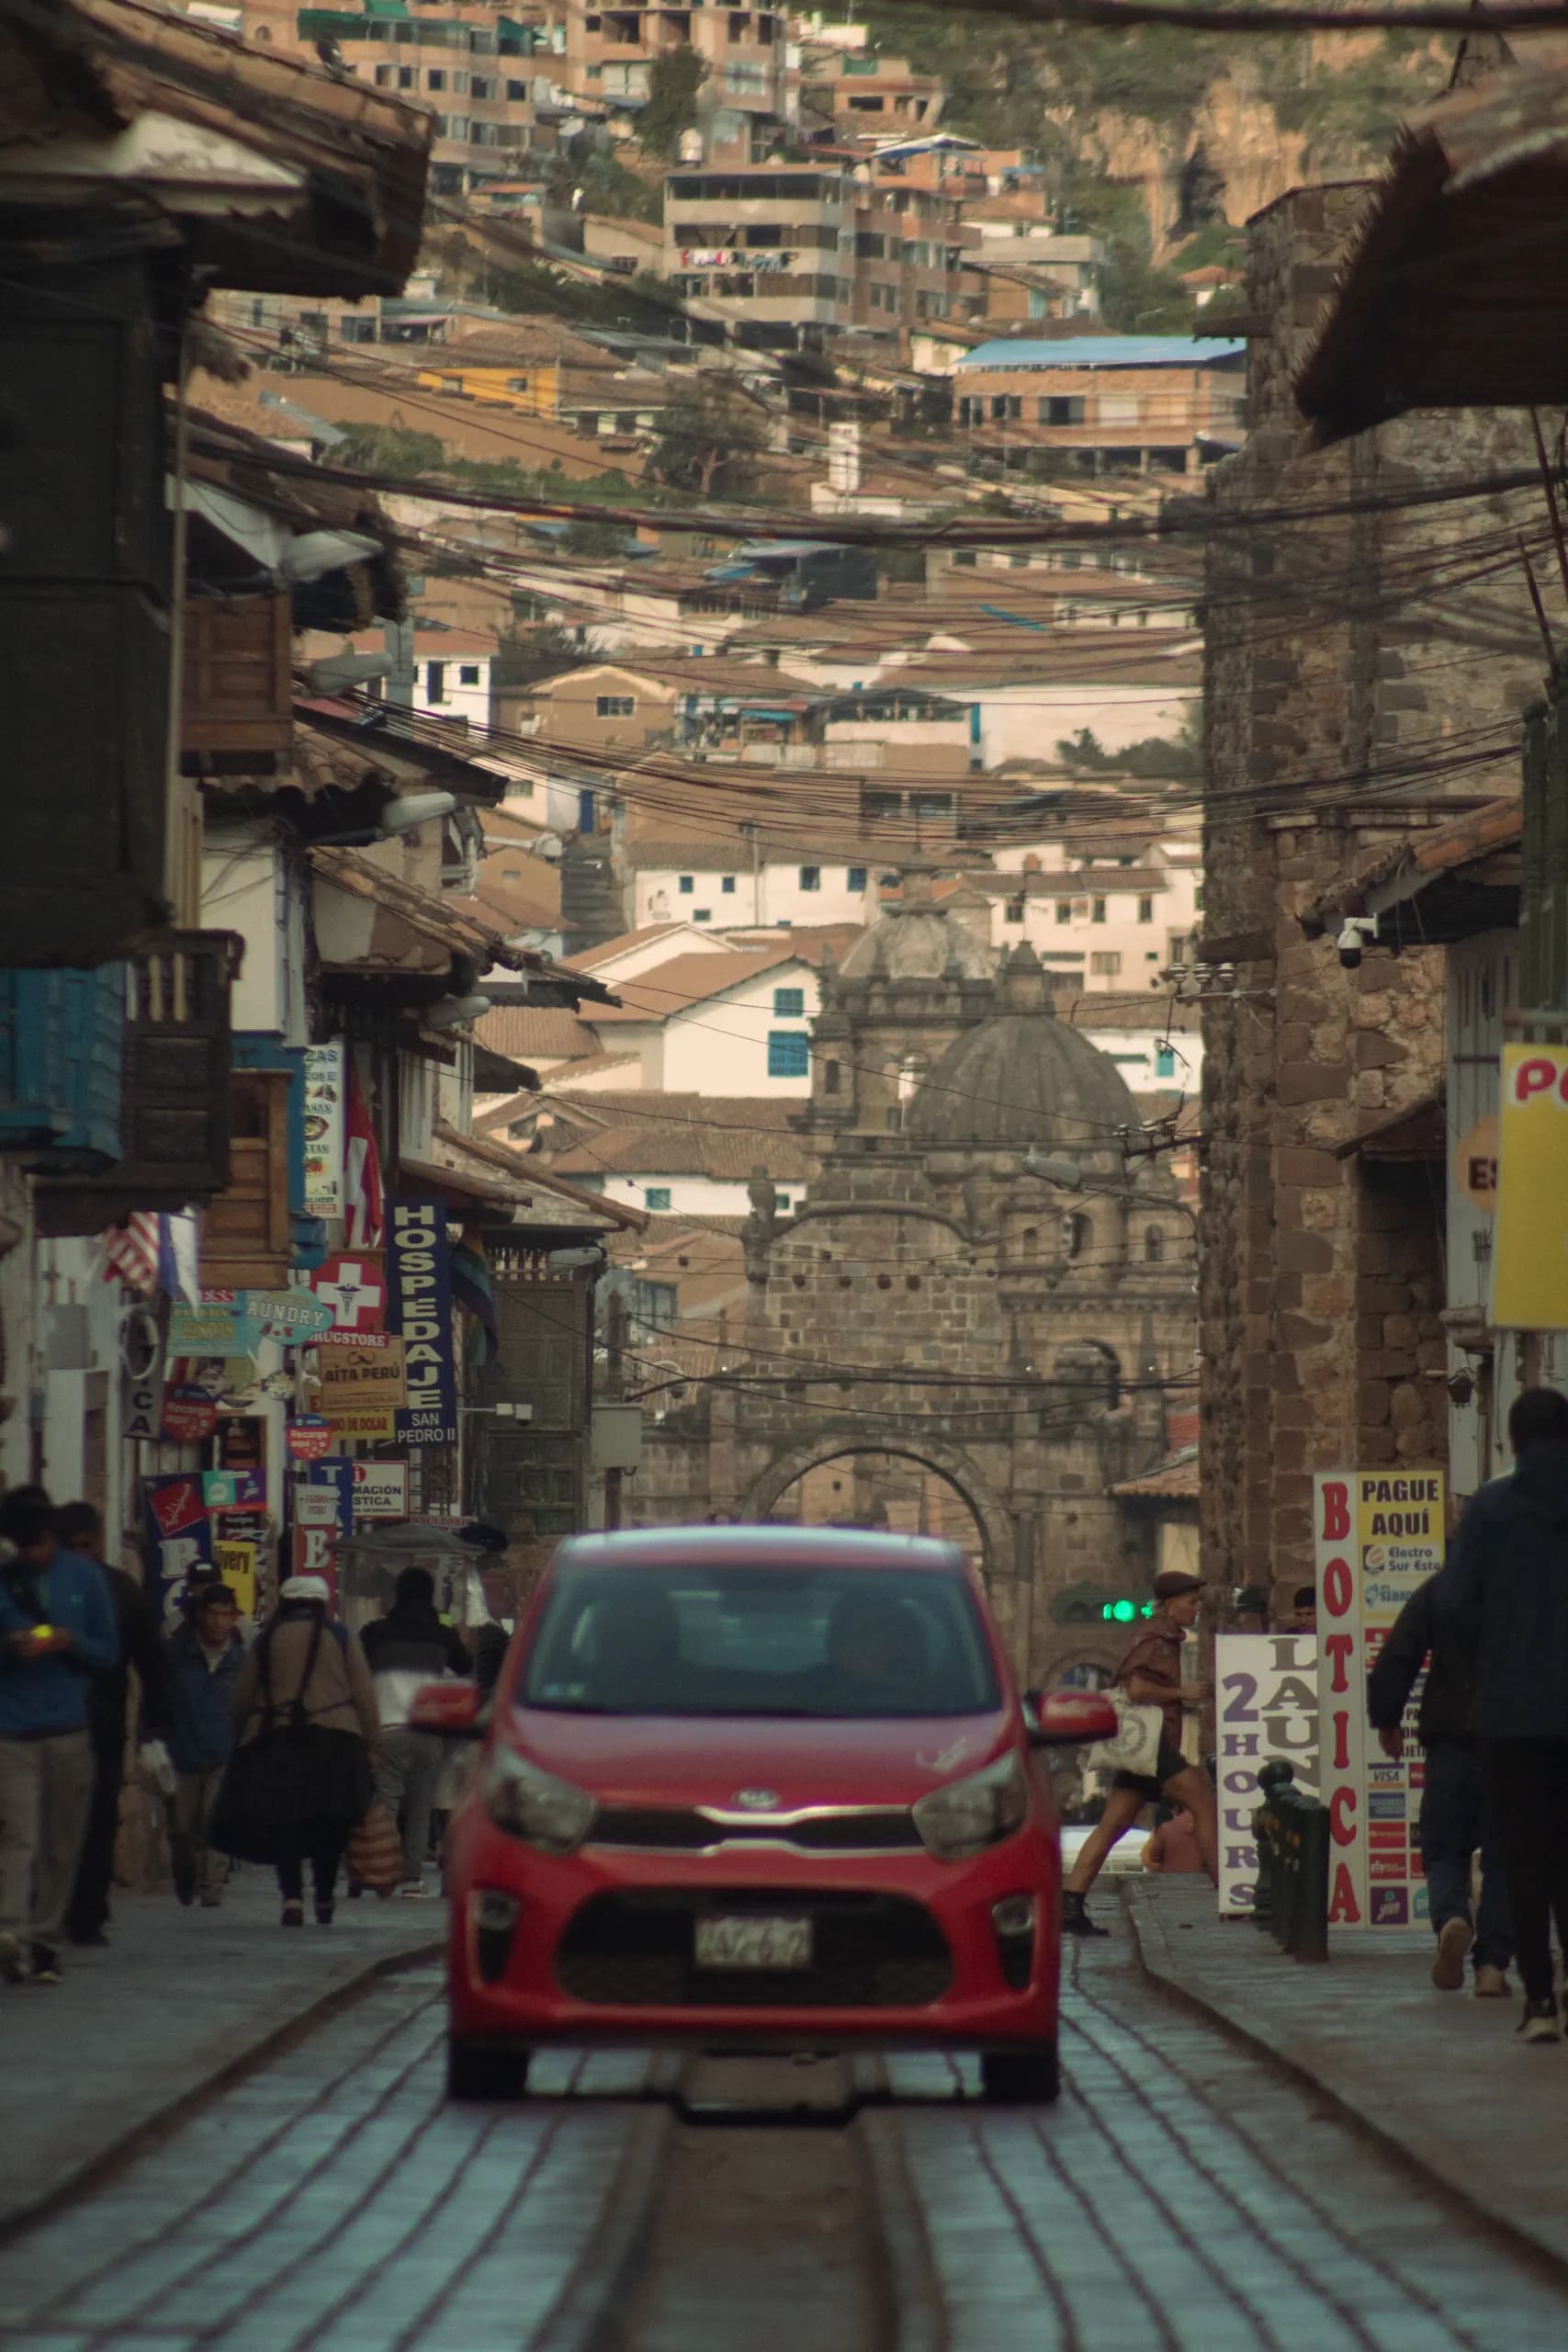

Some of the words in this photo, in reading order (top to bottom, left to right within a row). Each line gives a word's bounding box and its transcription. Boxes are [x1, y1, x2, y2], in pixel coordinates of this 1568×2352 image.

[394, 1204, 443, 1409] HOSPEDAJE
[412, 1413, 439, 1427] SAN
[397, 1429, 445, 1443] PEDRO
[1361, 1477, 1439, 1502] PAGUE
[1371, 1508, 1430, 1537] AQUÍ
[1388, 1560, 1410, 1572] Sur
[1223, 1673, 1258, 1722] 2
[1321, 1481, 1360, 1923] BOTICA
[1373, 1770, 1400, 1782] VISA
[1223, 1734, 1259, 1905] HOURS
